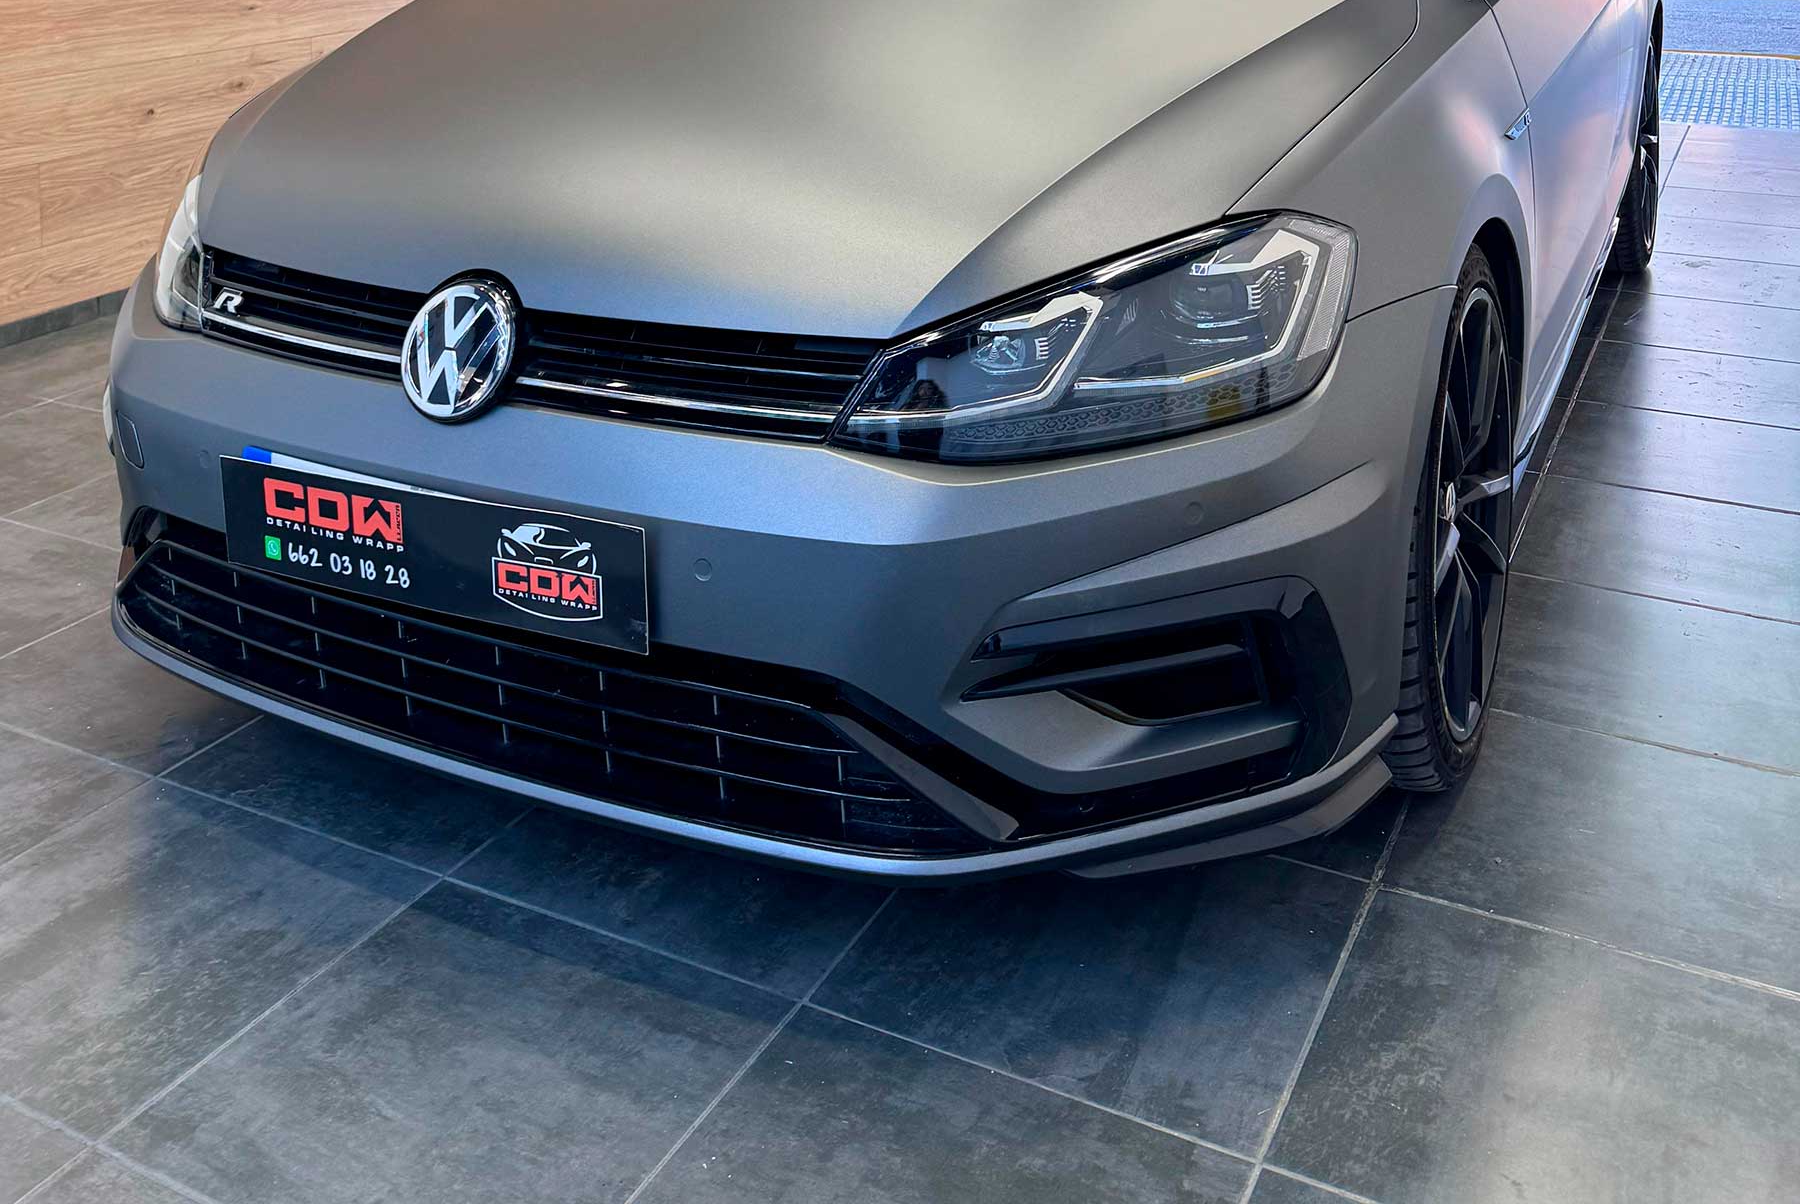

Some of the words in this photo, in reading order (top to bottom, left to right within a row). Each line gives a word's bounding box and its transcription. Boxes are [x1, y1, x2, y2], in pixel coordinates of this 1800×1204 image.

[213, 287, 244, 313] R
[263, 477, 404, 544] CDW
[288, 542, 323, 567] 662
[329, 553, 353, 575] 03
[359, 558, 377, 581] 18
[384, 564, 411, 589] 28
[352, 535, 404, 553] WRAPP
[497, 562, 597, 605] CDW
